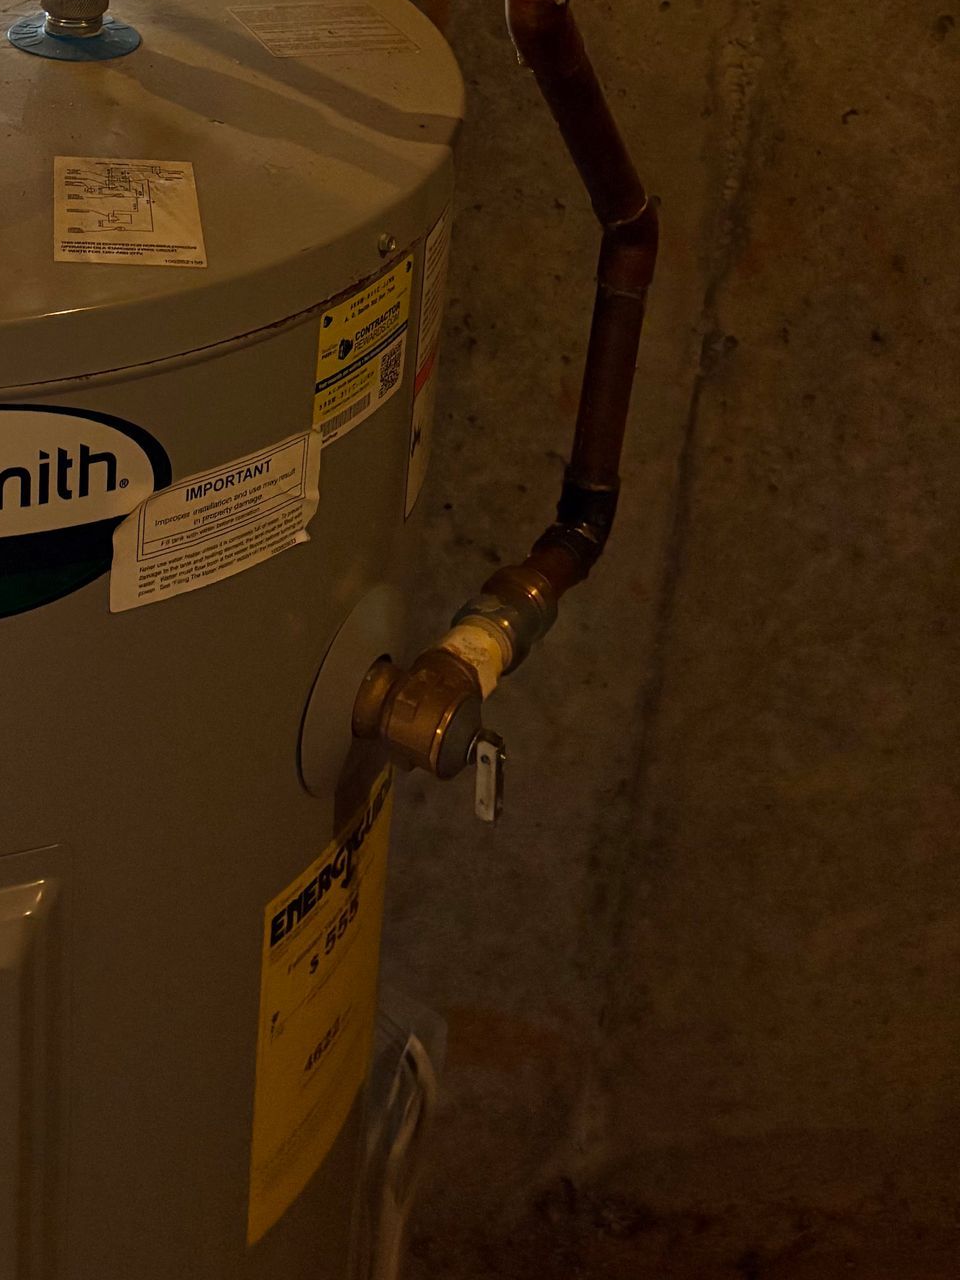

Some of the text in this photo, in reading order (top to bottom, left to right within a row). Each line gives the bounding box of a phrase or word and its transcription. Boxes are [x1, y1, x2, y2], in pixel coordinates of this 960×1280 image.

[354, 301, 401, 341] CONTRACTOR
[154, 467, 297, 527] Improper installation and use may result
[185, 458, 273, 503] IMPORTANT
[193, 516, 201, 525] in
[201, 506, 233, 525] property
